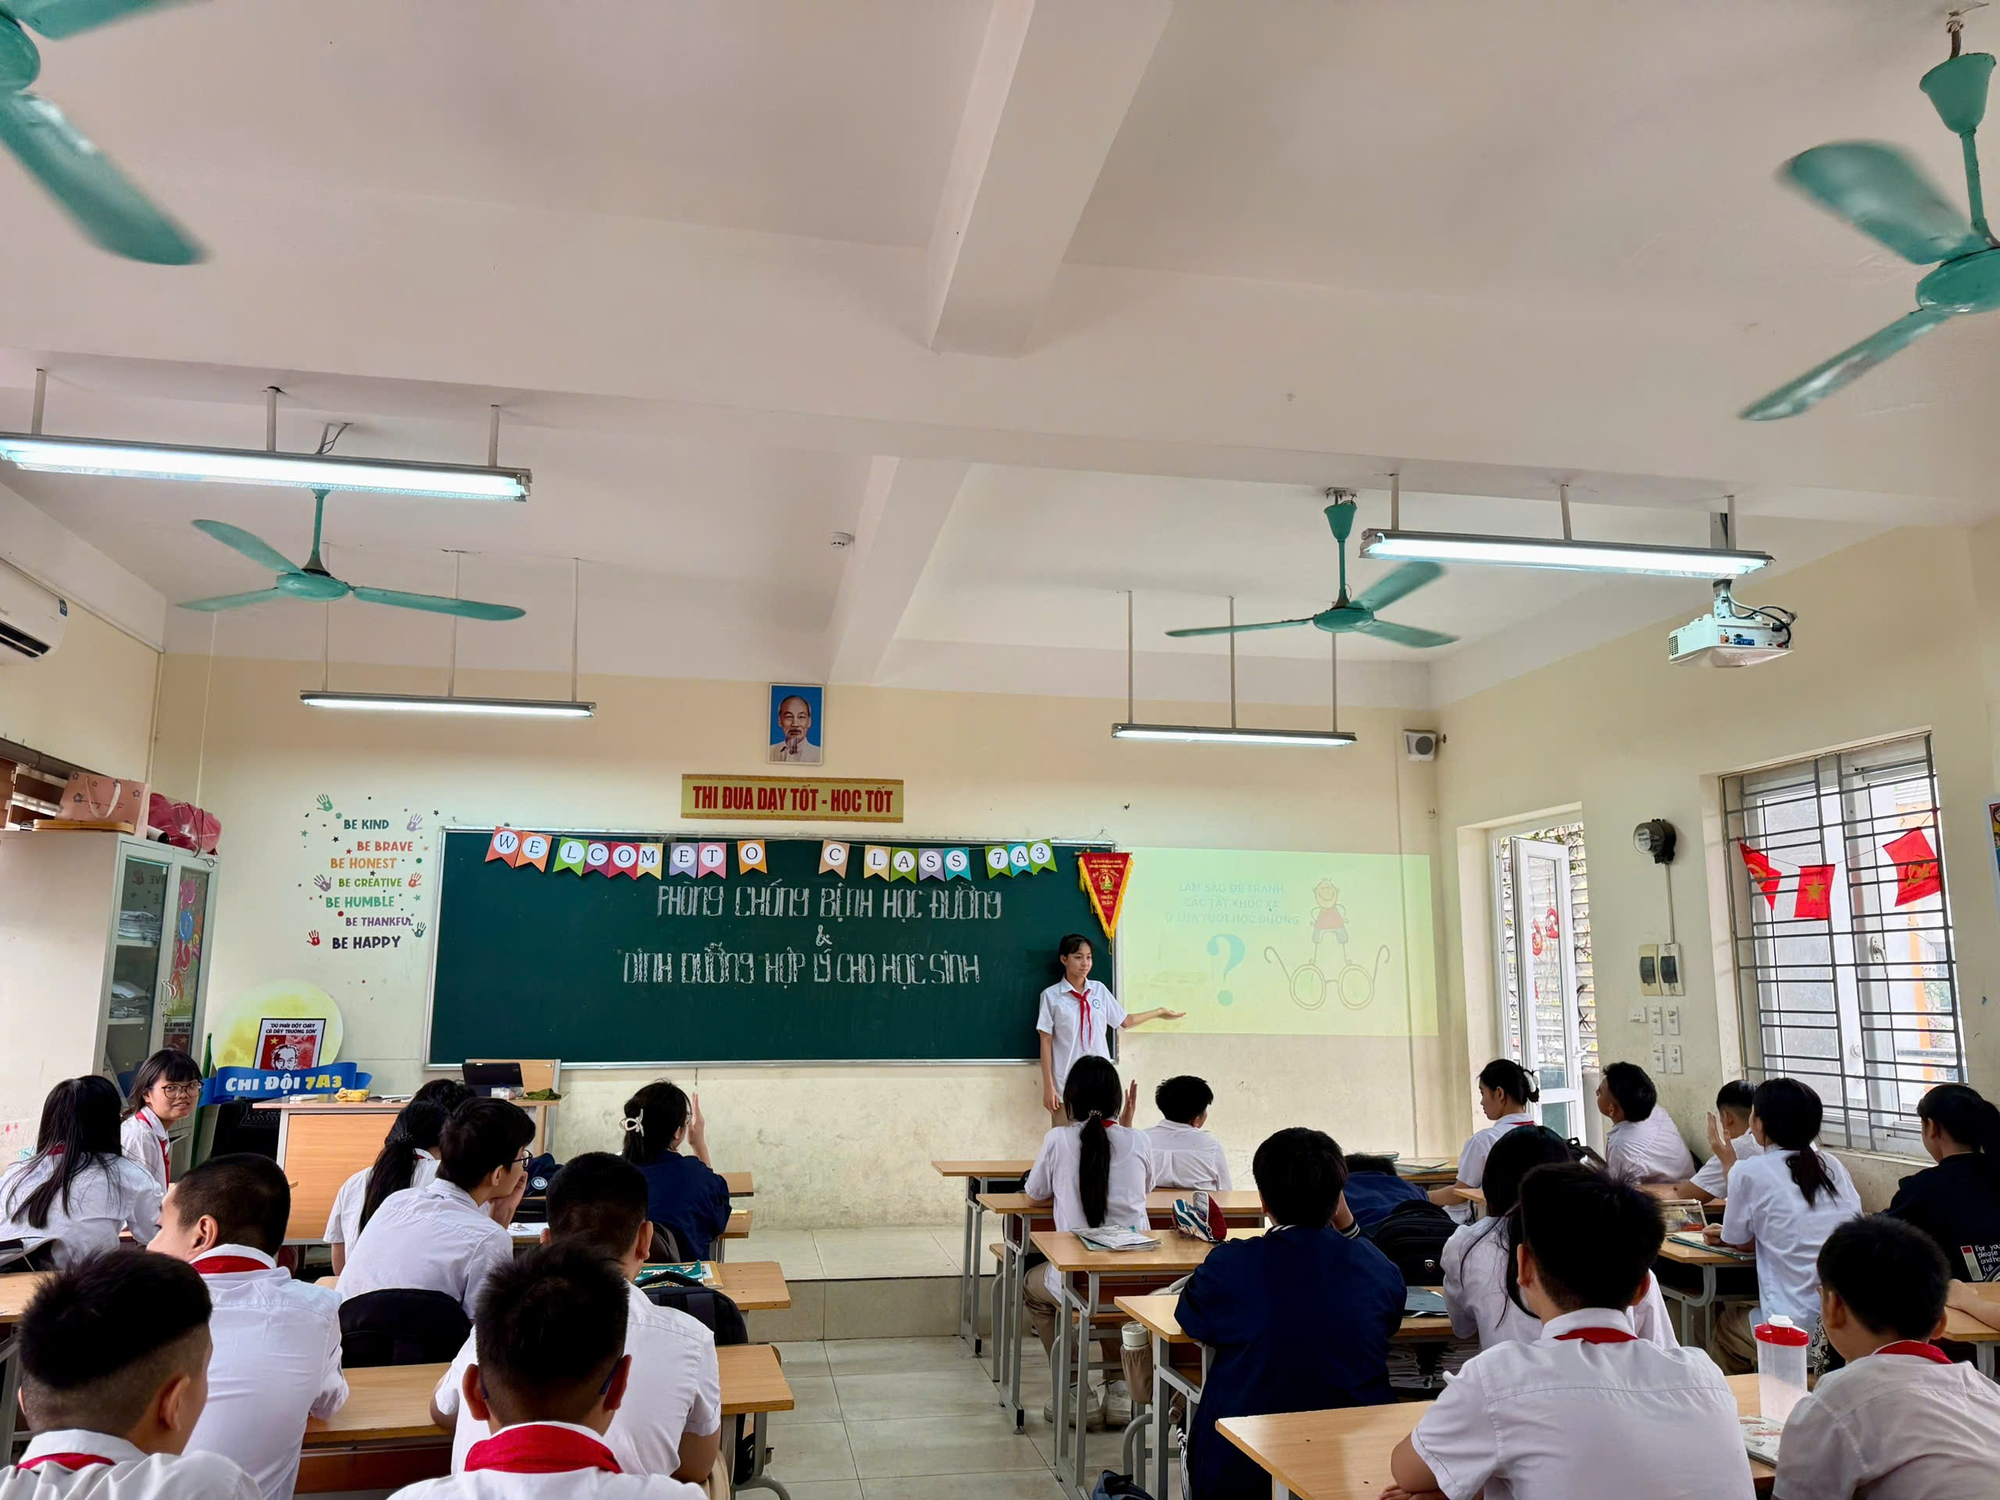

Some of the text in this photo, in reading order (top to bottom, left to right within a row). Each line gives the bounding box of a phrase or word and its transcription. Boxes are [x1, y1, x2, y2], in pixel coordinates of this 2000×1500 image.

[693, 786, 718, 809] THI
[722, 786, 753, 810] ĐUA
[757, 787, 788, 813] DẠY
[790, 784, 819, 812] TỐT
[830, 789, 862, 814] HỌC
[865, 786, 893, 813] TỐT
[344, 819, 389, 830] BE KIND
[357, 841, 413, 852] BE BRAVE
[499, 834, 689, 864] WELCOME
[829, 847, 962, 868] CLASS
[993, 846, 1046, 866] 7A3
[331, 858, 397, 869] BE HONEST
[338, 878, 402, 888] BE CREATIVE
[325, 896, 395, 908] BE HUMBLE
[657, 881, 724, 917] PHÒNG
[735, 878, 809, 917] CHỐNG
[820, 882, 873, 922] BỆNH
[883, 888, 924, 922] HỌC
[345, 916, 413, 927] BE THANKFUL
[816, 925, 832, 946] &
[332, 936, 401, 949] BE HAPPY
[837, 953, 875, 984] CHO
[882, 953, 926, 990] HỌC
[930, 950, 980, 984] SINH
[225, 1073, 342, 1094] CHI ĐỘI 7A3
